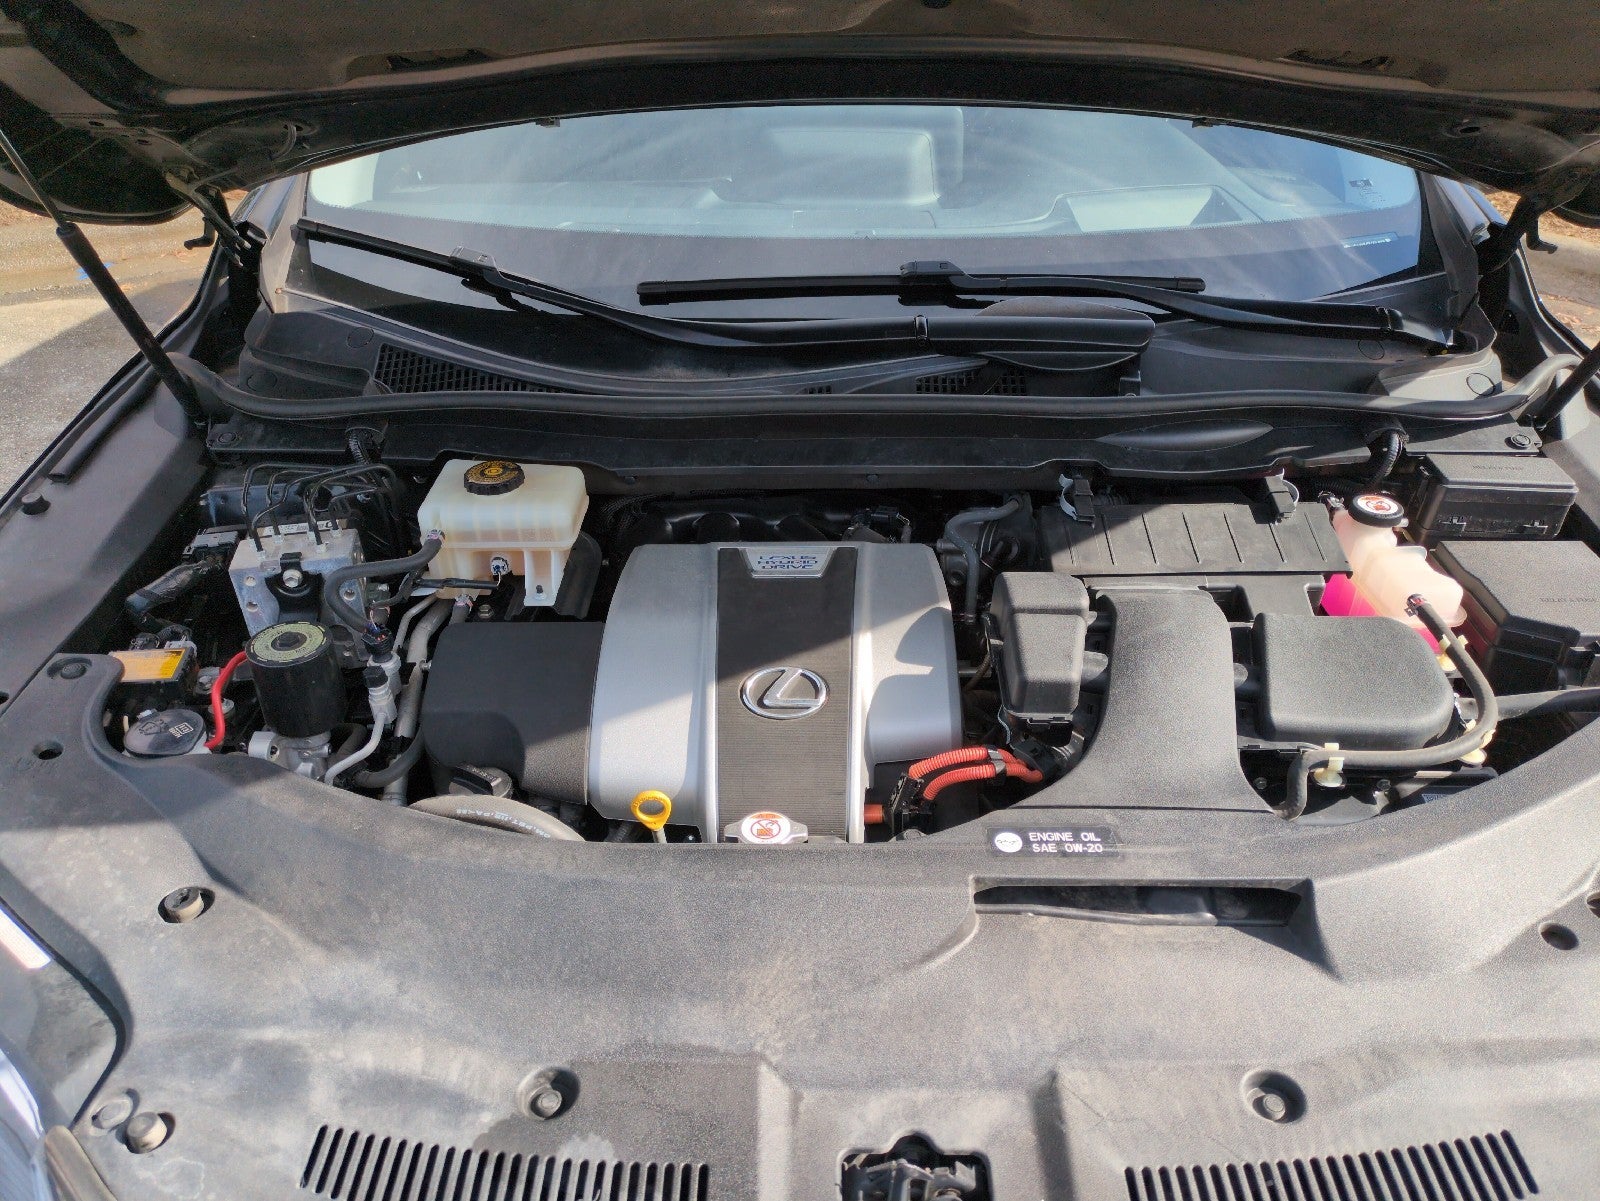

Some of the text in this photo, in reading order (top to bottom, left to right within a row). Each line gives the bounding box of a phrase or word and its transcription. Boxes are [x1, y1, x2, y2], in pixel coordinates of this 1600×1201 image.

[1029, 832, 1101, 842] ENGINE OIL
[1032, 843, 1058, 853] SAE
